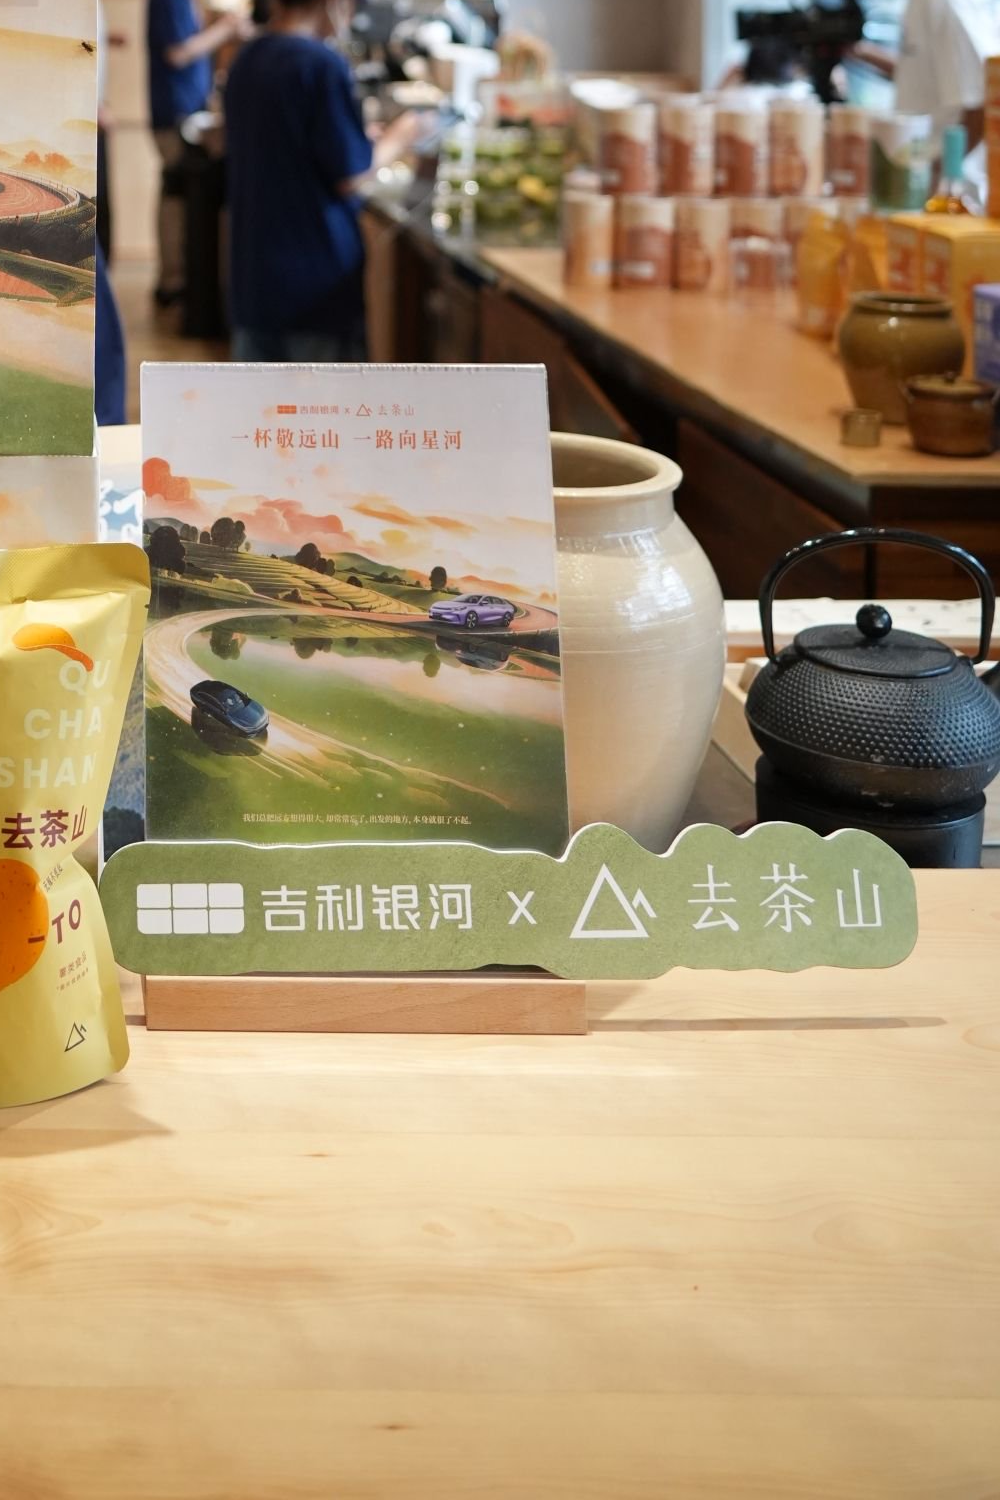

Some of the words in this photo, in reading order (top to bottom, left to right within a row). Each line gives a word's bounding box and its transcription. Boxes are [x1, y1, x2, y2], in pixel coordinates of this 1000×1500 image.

[231, 428, 340, 449] 一杯敬远山
[353, 429, 463, 451] 一路向星河
[59, 659, 112, 697] QU
[23, 705, 103, 741] CHA
[1, 804, 88, 851] 去茶山
[260, 883, 474, 932] 吉利银河
[687, 862, 884, 934] 去茶山
